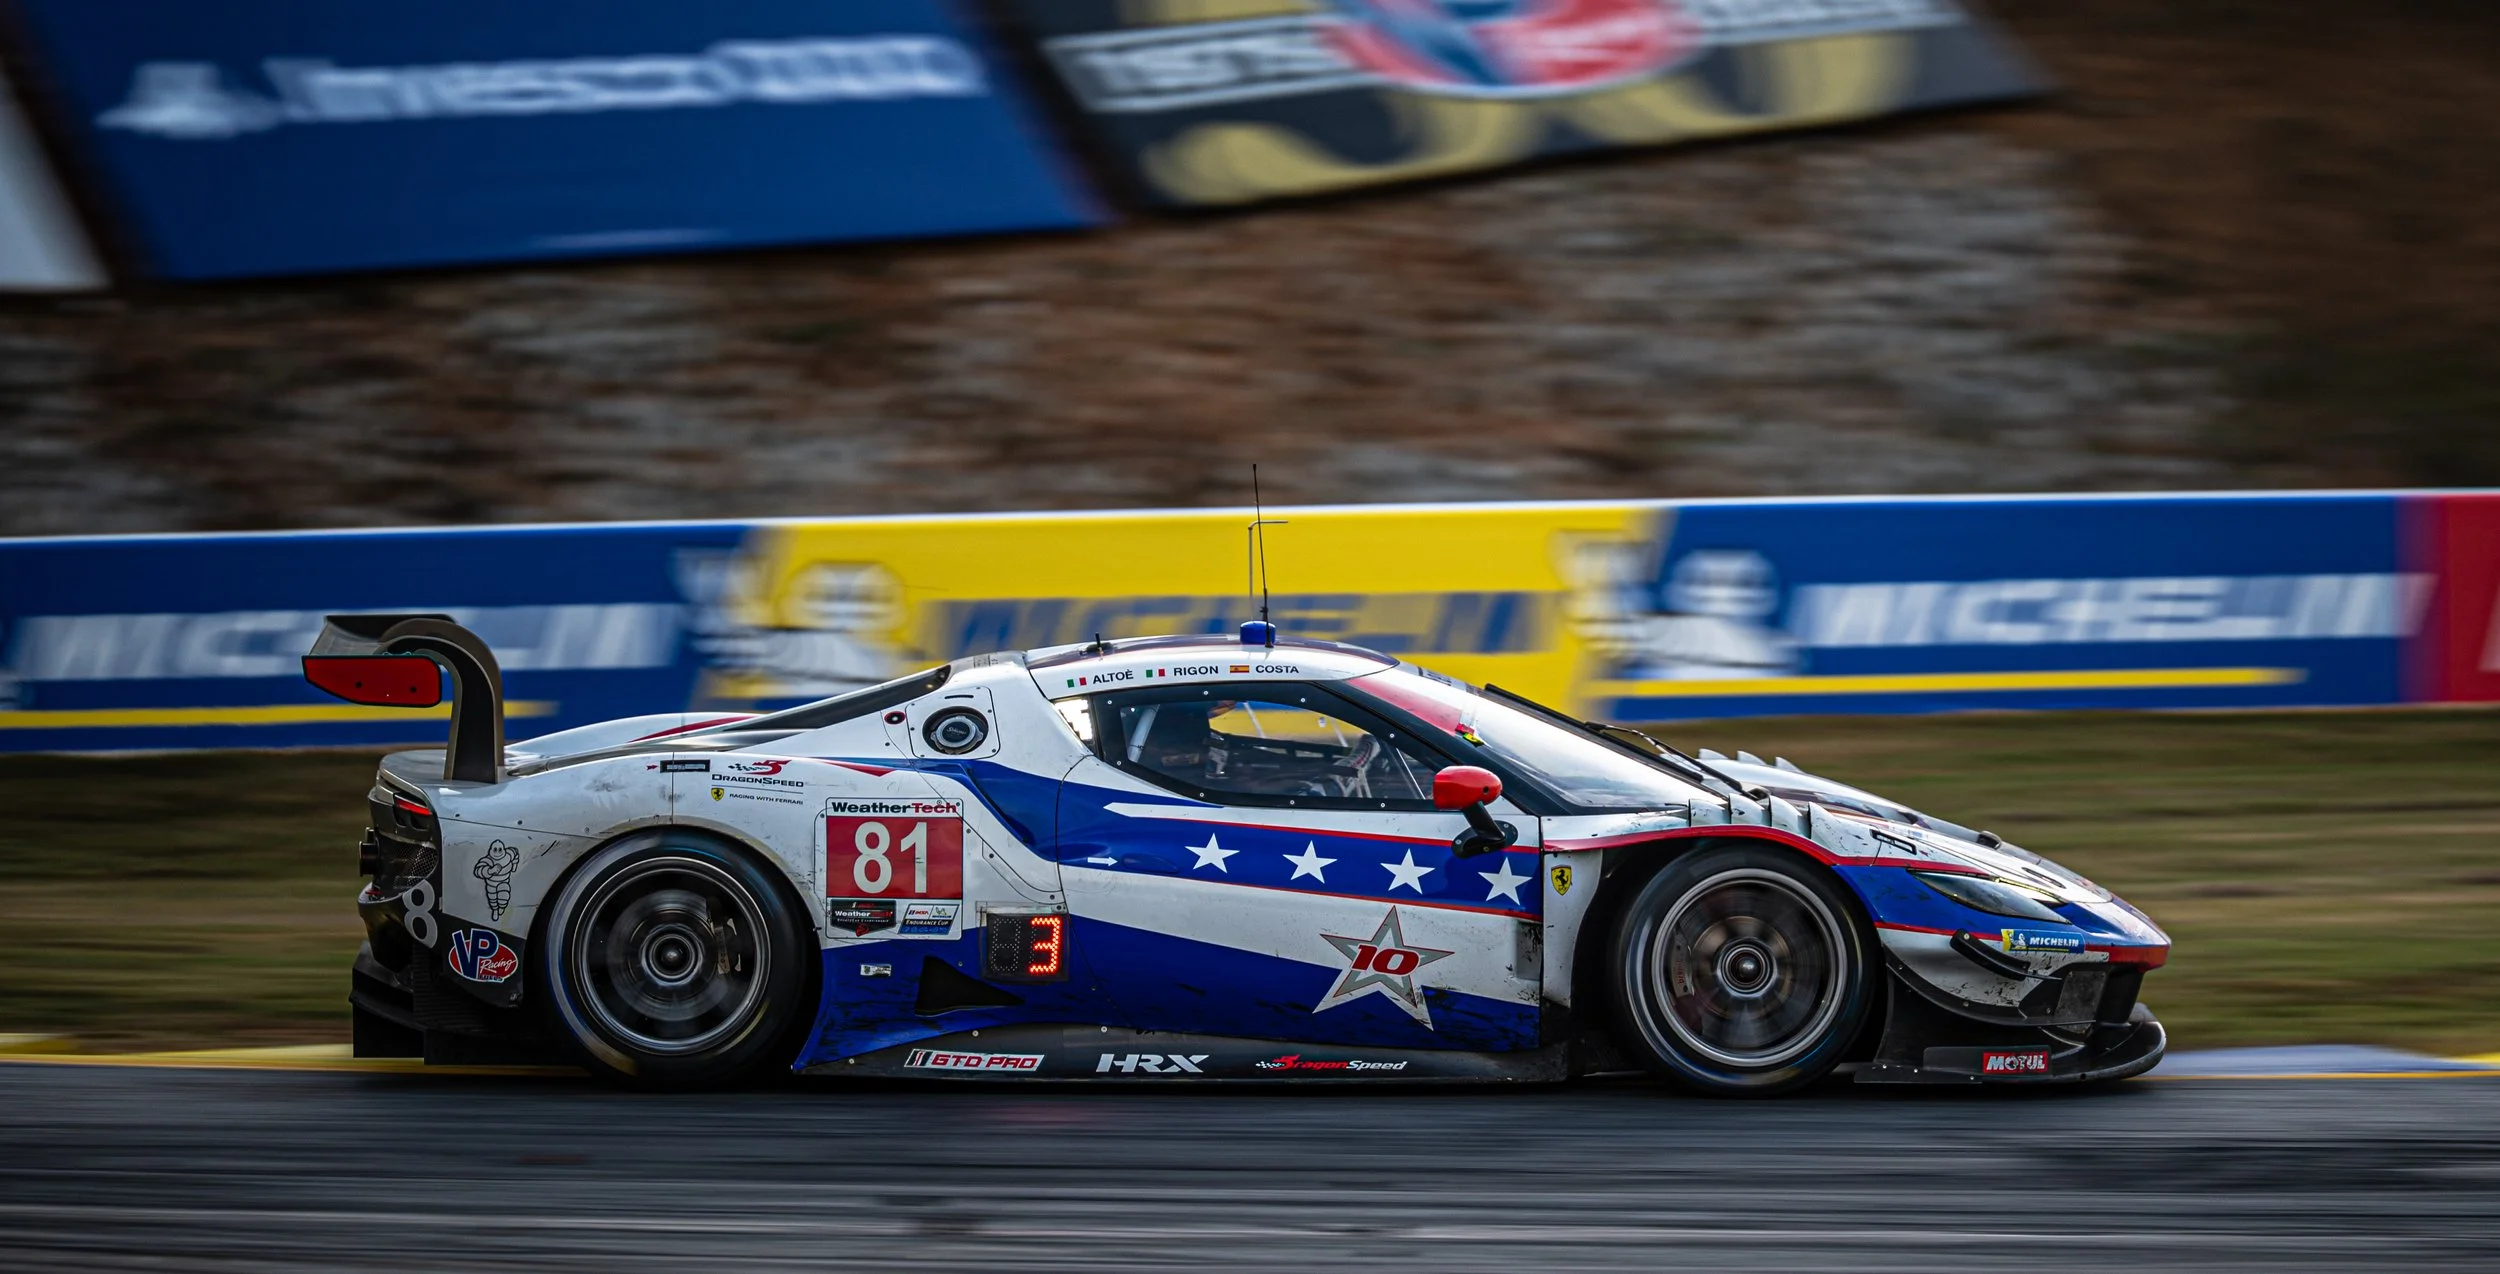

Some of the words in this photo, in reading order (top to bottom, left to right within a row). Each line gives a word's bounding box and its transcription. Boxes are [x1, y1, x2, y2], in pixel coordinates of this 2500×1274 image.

[1173, 665, 1219, 677] RIGON
[1255, 664, 1300, 674] COSTA
[775, 797, 804, 805] FERRARI
[831, 801, 957, 814] WeatherTech
[853, 821, 927, 894] 81
[1029, 917, 1060, 973] 3
[2029, 936, 2079, 947] MICHELIN
[452, 928, 499, 979] VP
[1351, 944, 1419, 975] 10
[480, 958, 518, 974] Racing
[931, 1053, 983, 1067] GTD
[985, 1055, 1038, 1069] PRO
[1095, 1053, 1210, 1073] HRX
[1986, 1055, 2045, 1070] MOTUL
